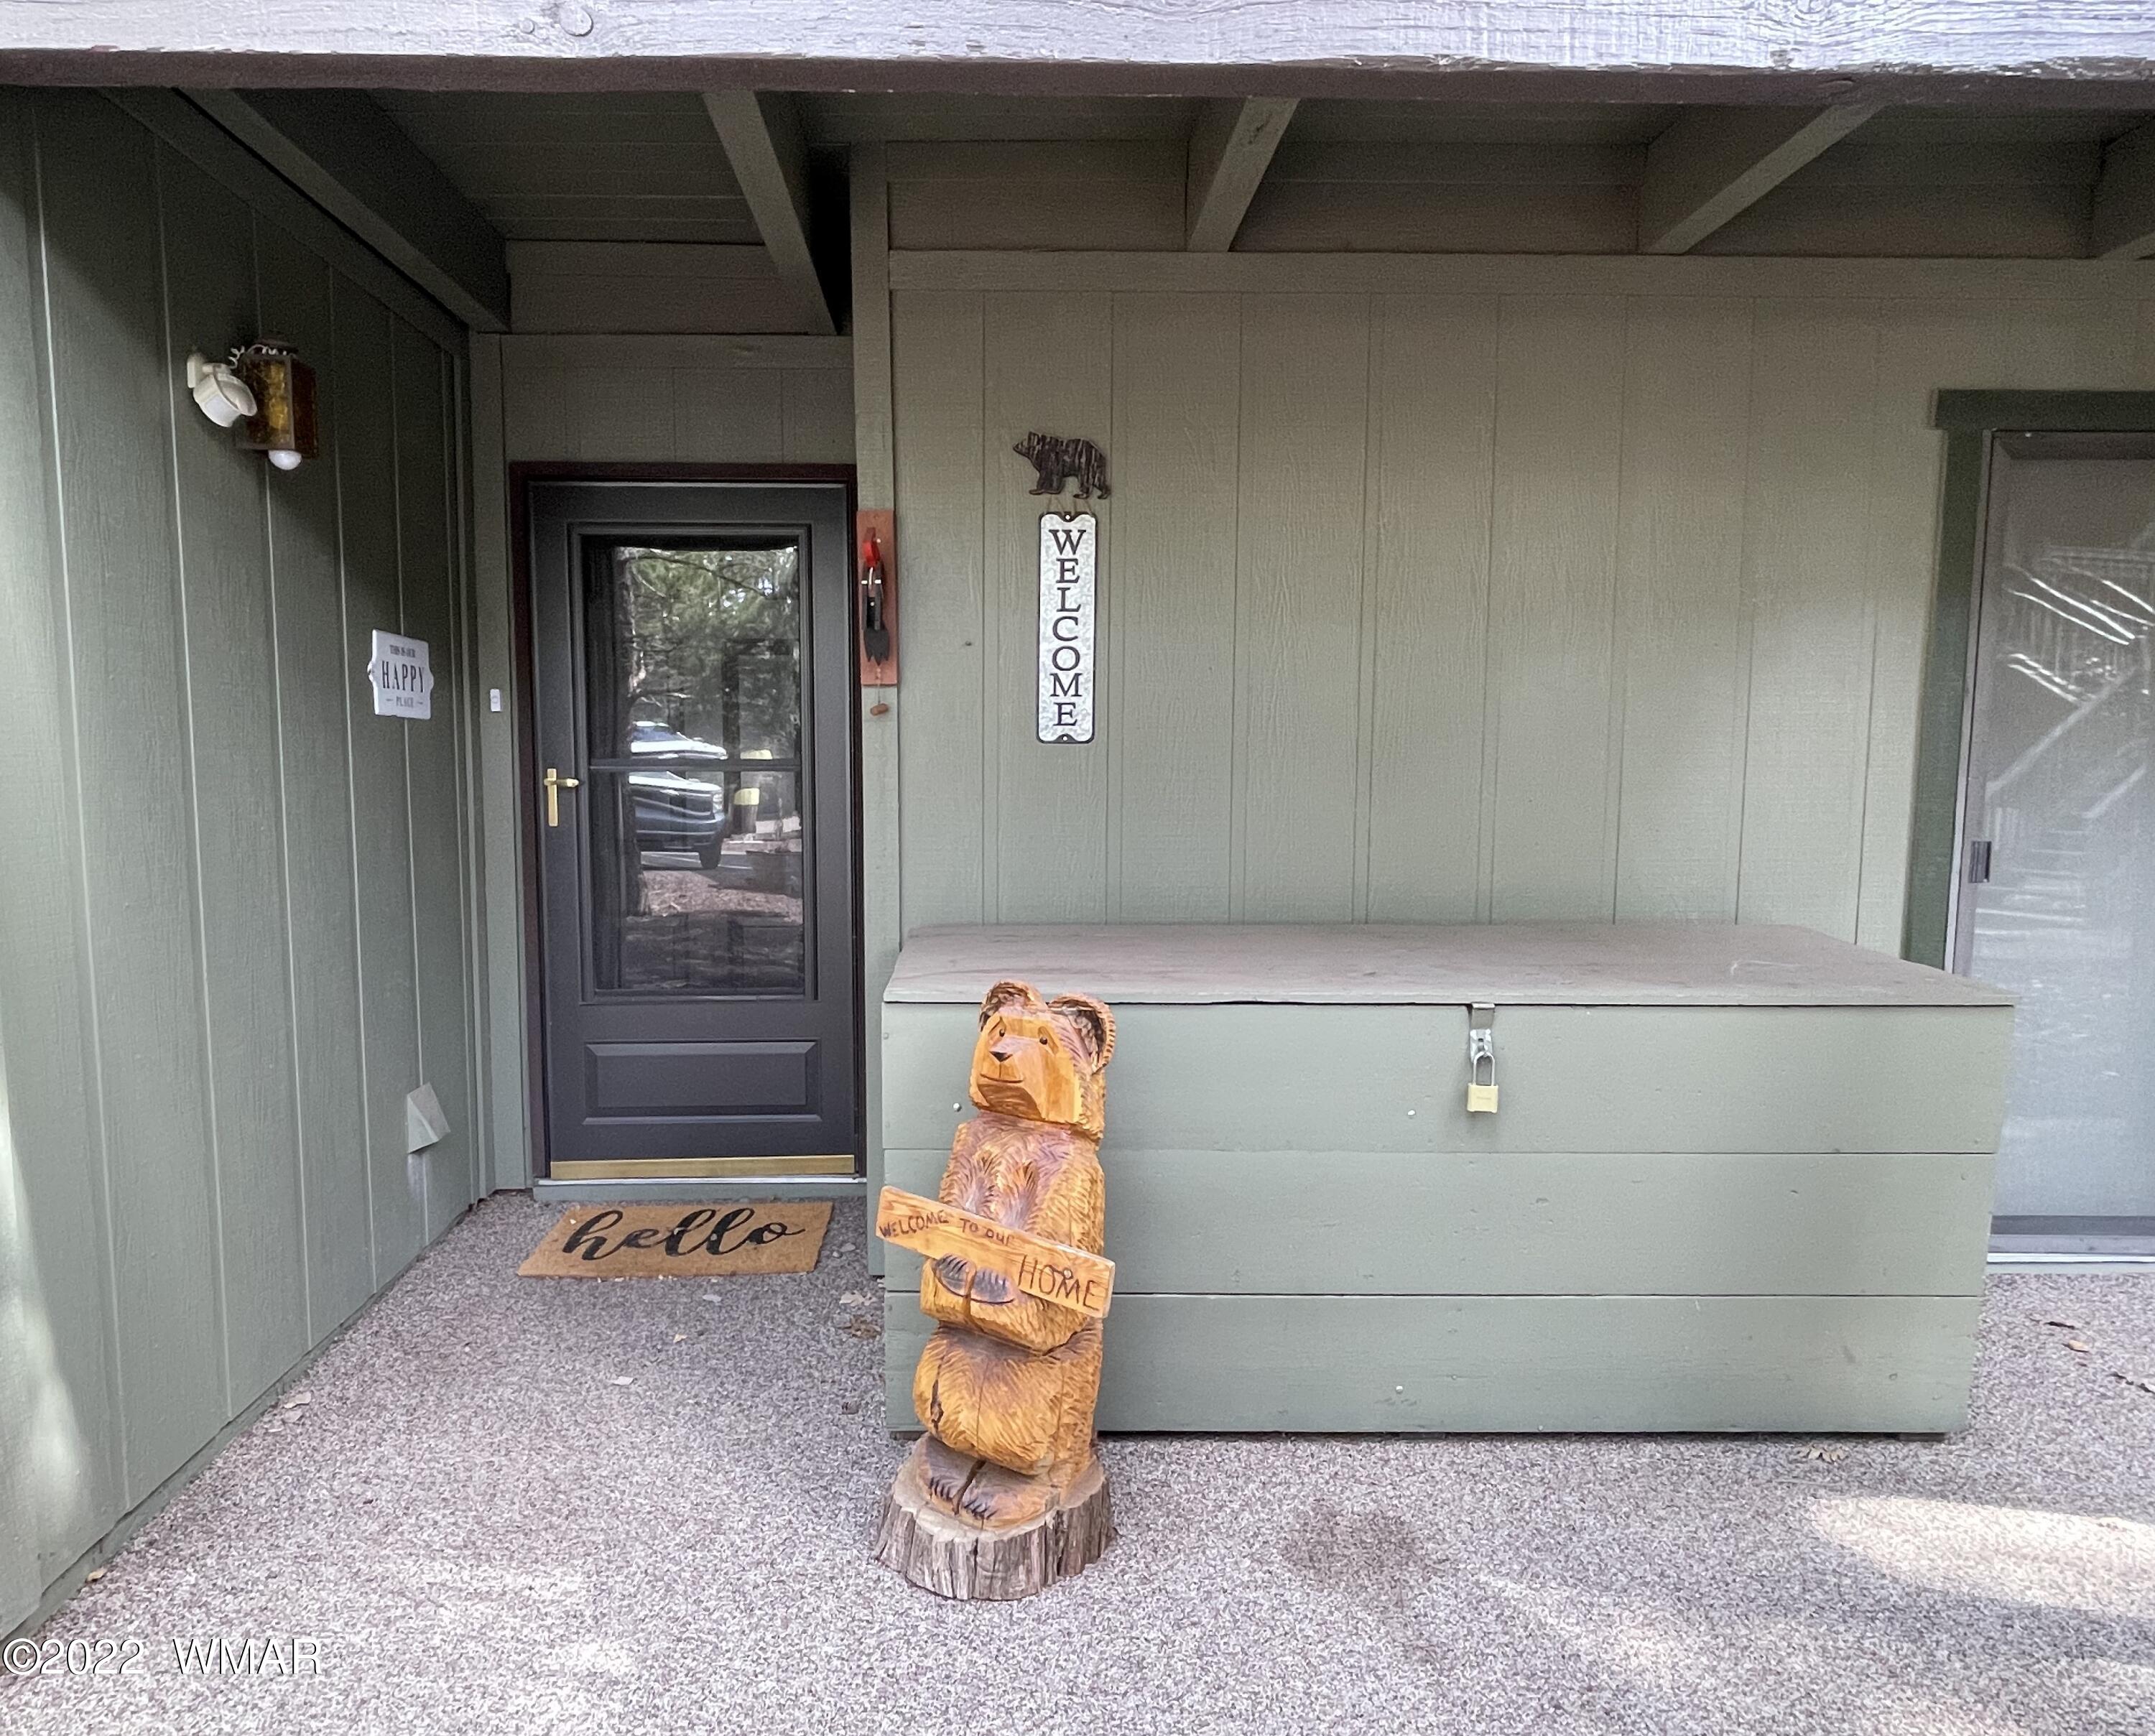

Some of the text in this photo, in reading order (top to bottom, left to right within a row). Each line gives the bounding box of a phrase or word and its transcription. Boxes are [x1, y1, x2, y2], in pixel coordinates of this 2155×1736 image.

[1048, 529, 1086, 726] WELCOME
[381, 661, 425, 692] HAPPY
[396, 696, 414, 708] PLACE
[562, 1207, 805, 1261] hello
[879, 1210, 949, 1238] WELCOME
[1018, 1254, 1100, 1311] HOME
